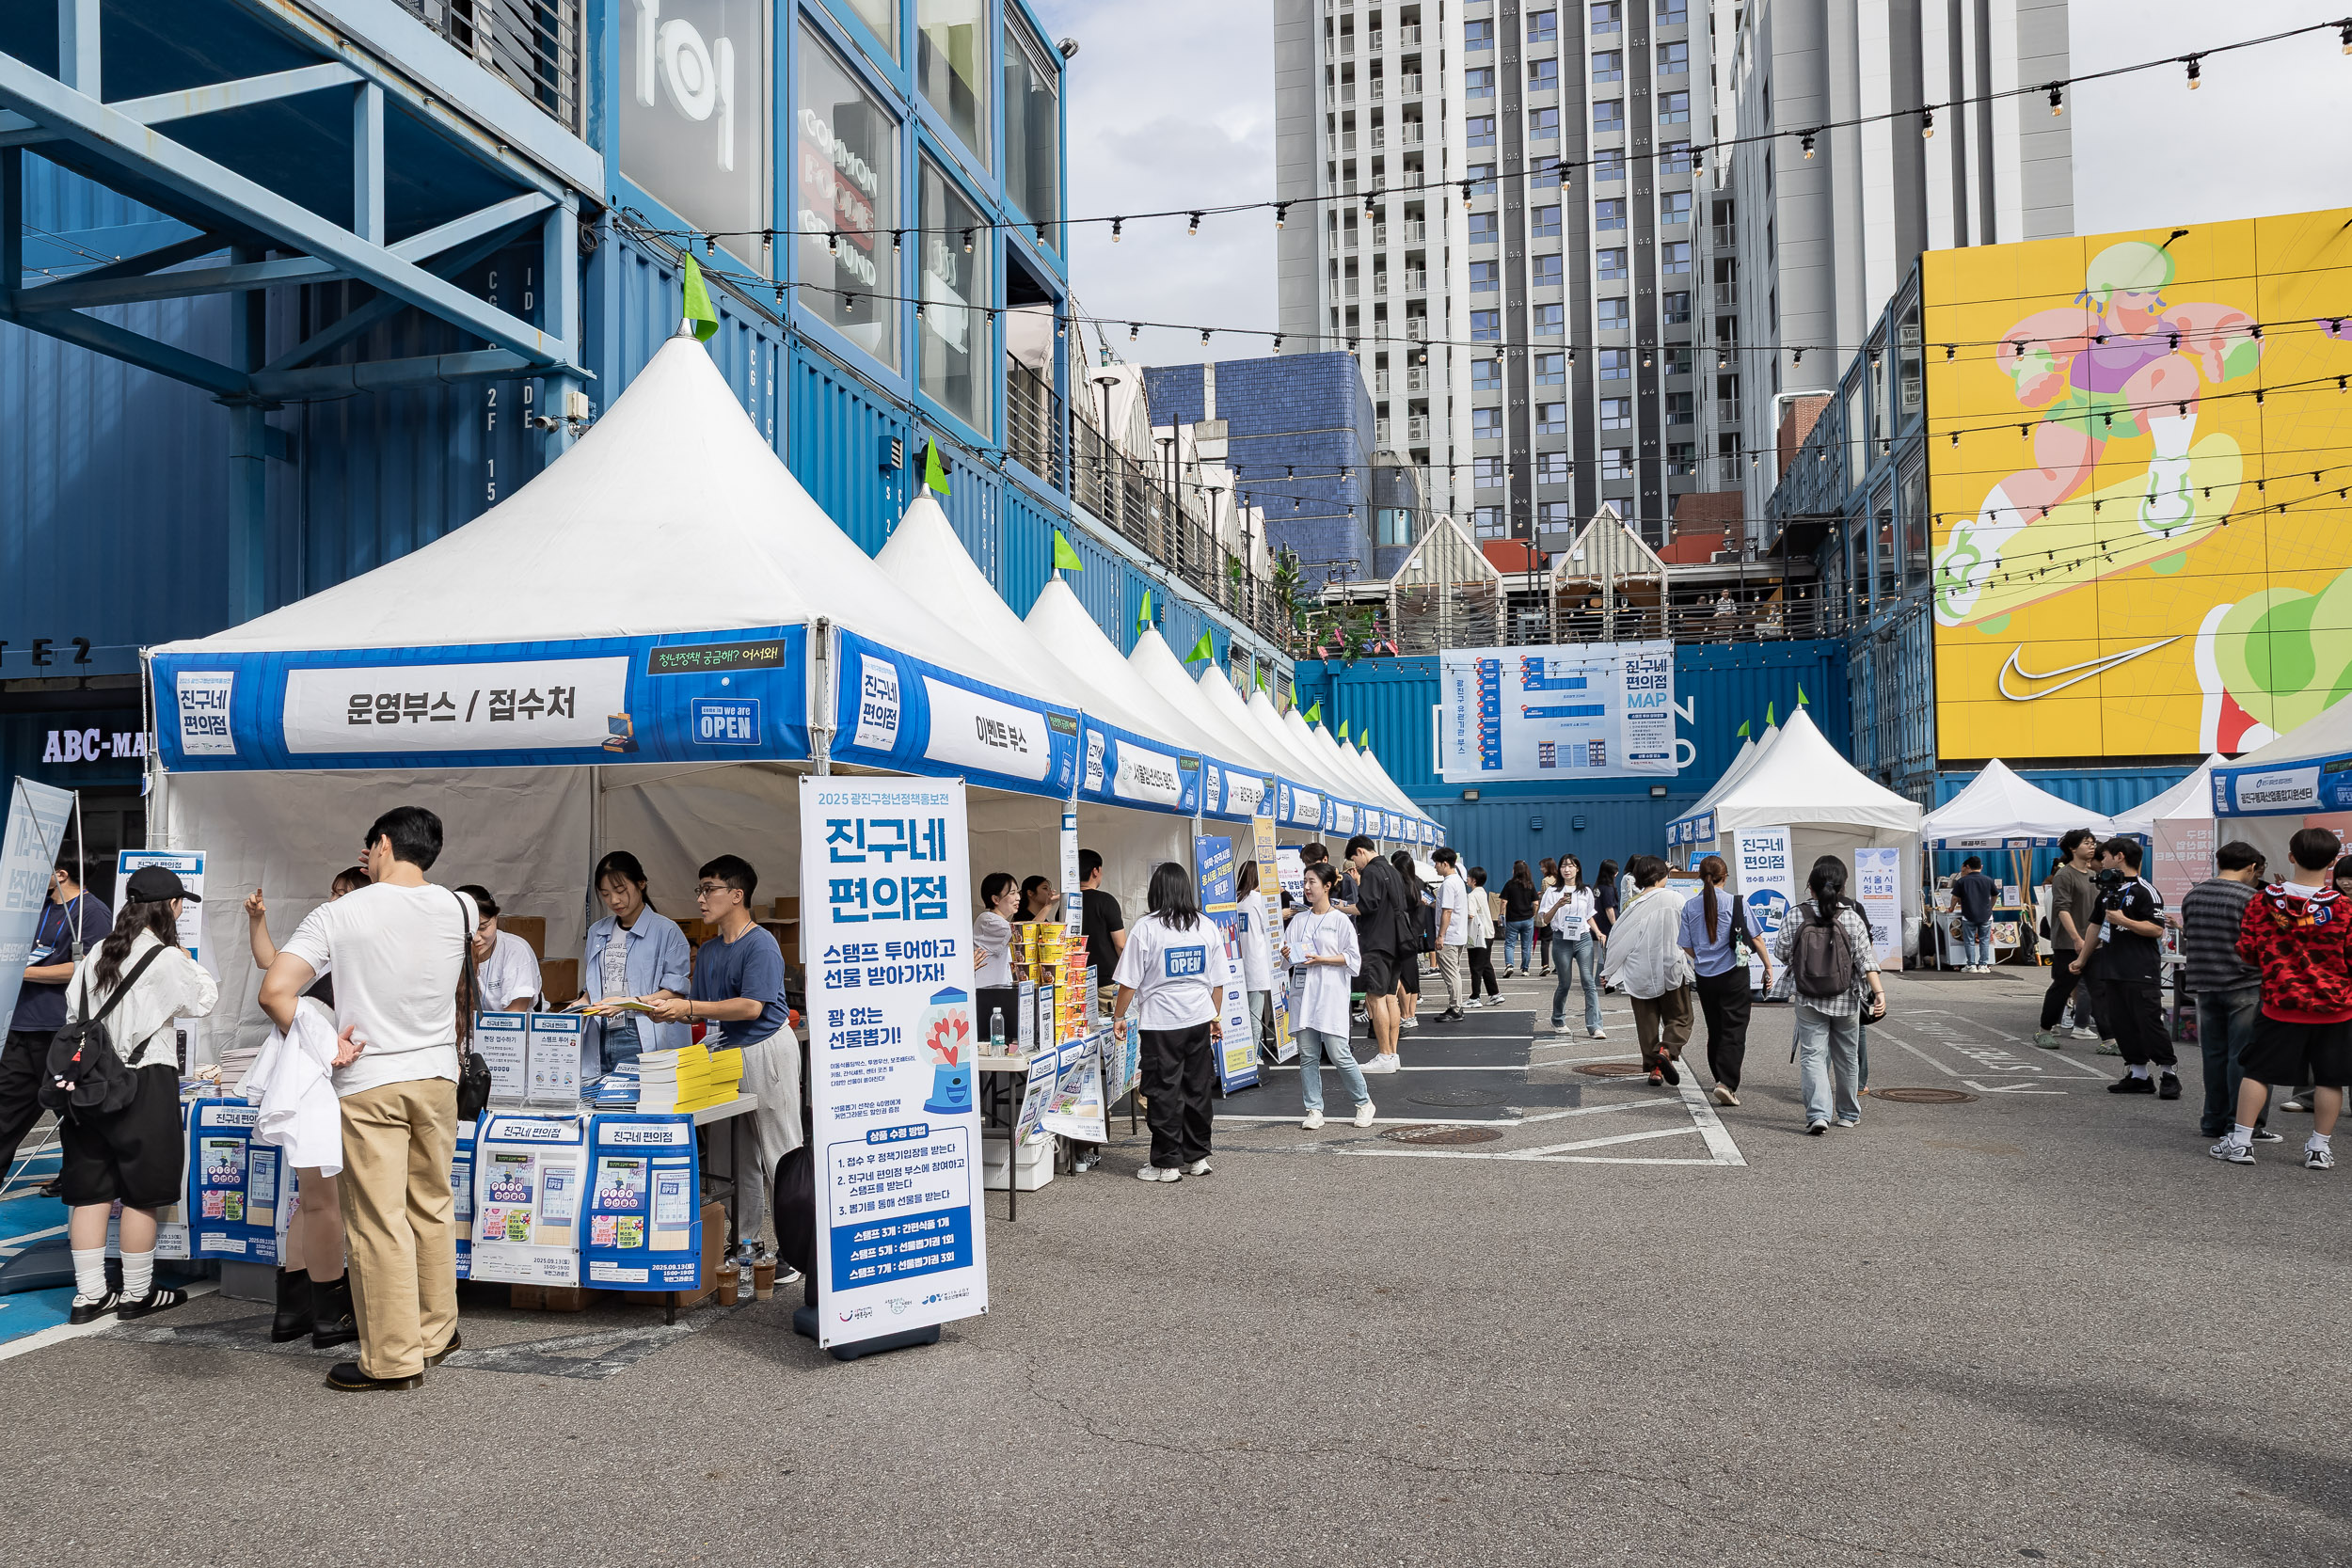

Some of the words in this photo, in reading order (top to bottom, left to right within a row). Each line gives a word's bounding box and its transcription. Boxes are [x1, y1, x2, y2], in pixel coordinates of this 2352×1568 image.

[799, 108, 877, 198] COMMON
[799, 209, 877, 287] GROUND
[659, 651, 701, 668] 청년정책
[703, 649, 739, 666] 궁금해?
[742, 647, 778, 661] 어서와!
[1626, 658, 1667, 674] 진구네
[864, 673, 898, 704] 진구네
[1626, 675, 1667, 690] 편의점
[181, 689, 228, 710] 진구네
[347, 690, 457, 725] 운영부스
[488, 686, 576, 722] 접수처
[1628, 692, 1667, 708] MAP
[737, 706, 751, 716] are
[863, 703, 897, 731] 편의점
[183, 715, 228, 736] 편의점
[701, 716, 751, 738] OPEN
[975, 715, 1008, 750] 이벤트
[1007, 724, 1028, 752] 부스
[1458, 738, 1465, 754] 부스
[818, 793, 849, 805] 2025
[850, 792, 949, 805] 광진구청년정책홍보전
[825, 817, 946, 863] 진구네
[1741, 837, 1784, 853] 진구네
[1743, 855, 1785, 870] 편의점
[1201, 869, 1217, 887] 응시료
[1214, 879, 1229, 896] 확대!
[1863, 875, 1893, 883] 서울시
[828, 875, 948, 924] 편의점
[823, 942, 880, 965] 스탬프
[884, 939, 957, 961] 투어하고
[1170, 957, 1201, 974] OPEN
[823, 967, 862, 990] 선물
[866, 963, 946, 987] 받아가자!
[827, 1008, 845, 1028] 꽝
[850, 1006, 883, 1026] 없는
[496, 1036, 516, 1044] 접수하기
[828, 1026, 901, 1051] 선물뽑기!
[215, 1114, 241, 1124] 진구네
[503, 1126, 532, 1137] 진구네
[532, 1128, 562, 1138] 편의점
[613, 1131, 642, 1143] 진구네
[643, 1132, 673, 1144] 편의점
[869, 1131, 888, 1142] 상품
[889, 1128, 908, 1139] 수령
[908, 1125, 926, 1137] 방법
[837, 1159, 845, 1168] 1.
[847, 1156, 865, 1167] 접수
[866, 1154, 876, 1164] 후
[930, 1143, 956, 1156] 받는다
[837, 1176, 846, 1185] 2.
[848, 1172, 875, 1184] 진구네
[876, 1167, 902, 1180] 편의점
[904, 1164, 930, 1176] 부스에
[931, 1158, 965, 1172] 참여하고
[492, 1182, 523, 1191] PICK
[601, 1188, 634, 1198] PICK
[661, 1186, 677, 1195] OPEN
[849, 1183, 884, 1197] 스탬프를
[886, 1179, 913, 1192] 받는다
[838, 1206, 847, 1216] 3.
[849, 1200, 876, 1214] 뽑기를
[878, 1197, 896, 1210] 통해
[897, 1194, 923, 1206] 선물을
[925, 1189, 950, 1202] 받는다
[853, 1229, 881, 1243] 스탬프
[881, 1225, 897, 1238] 3개
[901, 1220, 936, 1234] 간편식품
[936, 1216, 950, 1228] 1개
[850, 1247, 877, 1261] 스탬프
[878, 1244, 893, 1257] 5개
[898, 1237, 941, 1253] 선물뽑기권
[941, 1233, 955, 1246] 1회
[849, 1266, 876, 1280] 스탬프
[877, 1262, 892, 1275] 7개
[898, 1255, 940, 1271] 선물뽑기권
[941, 1251, 955, 1263] 3회
